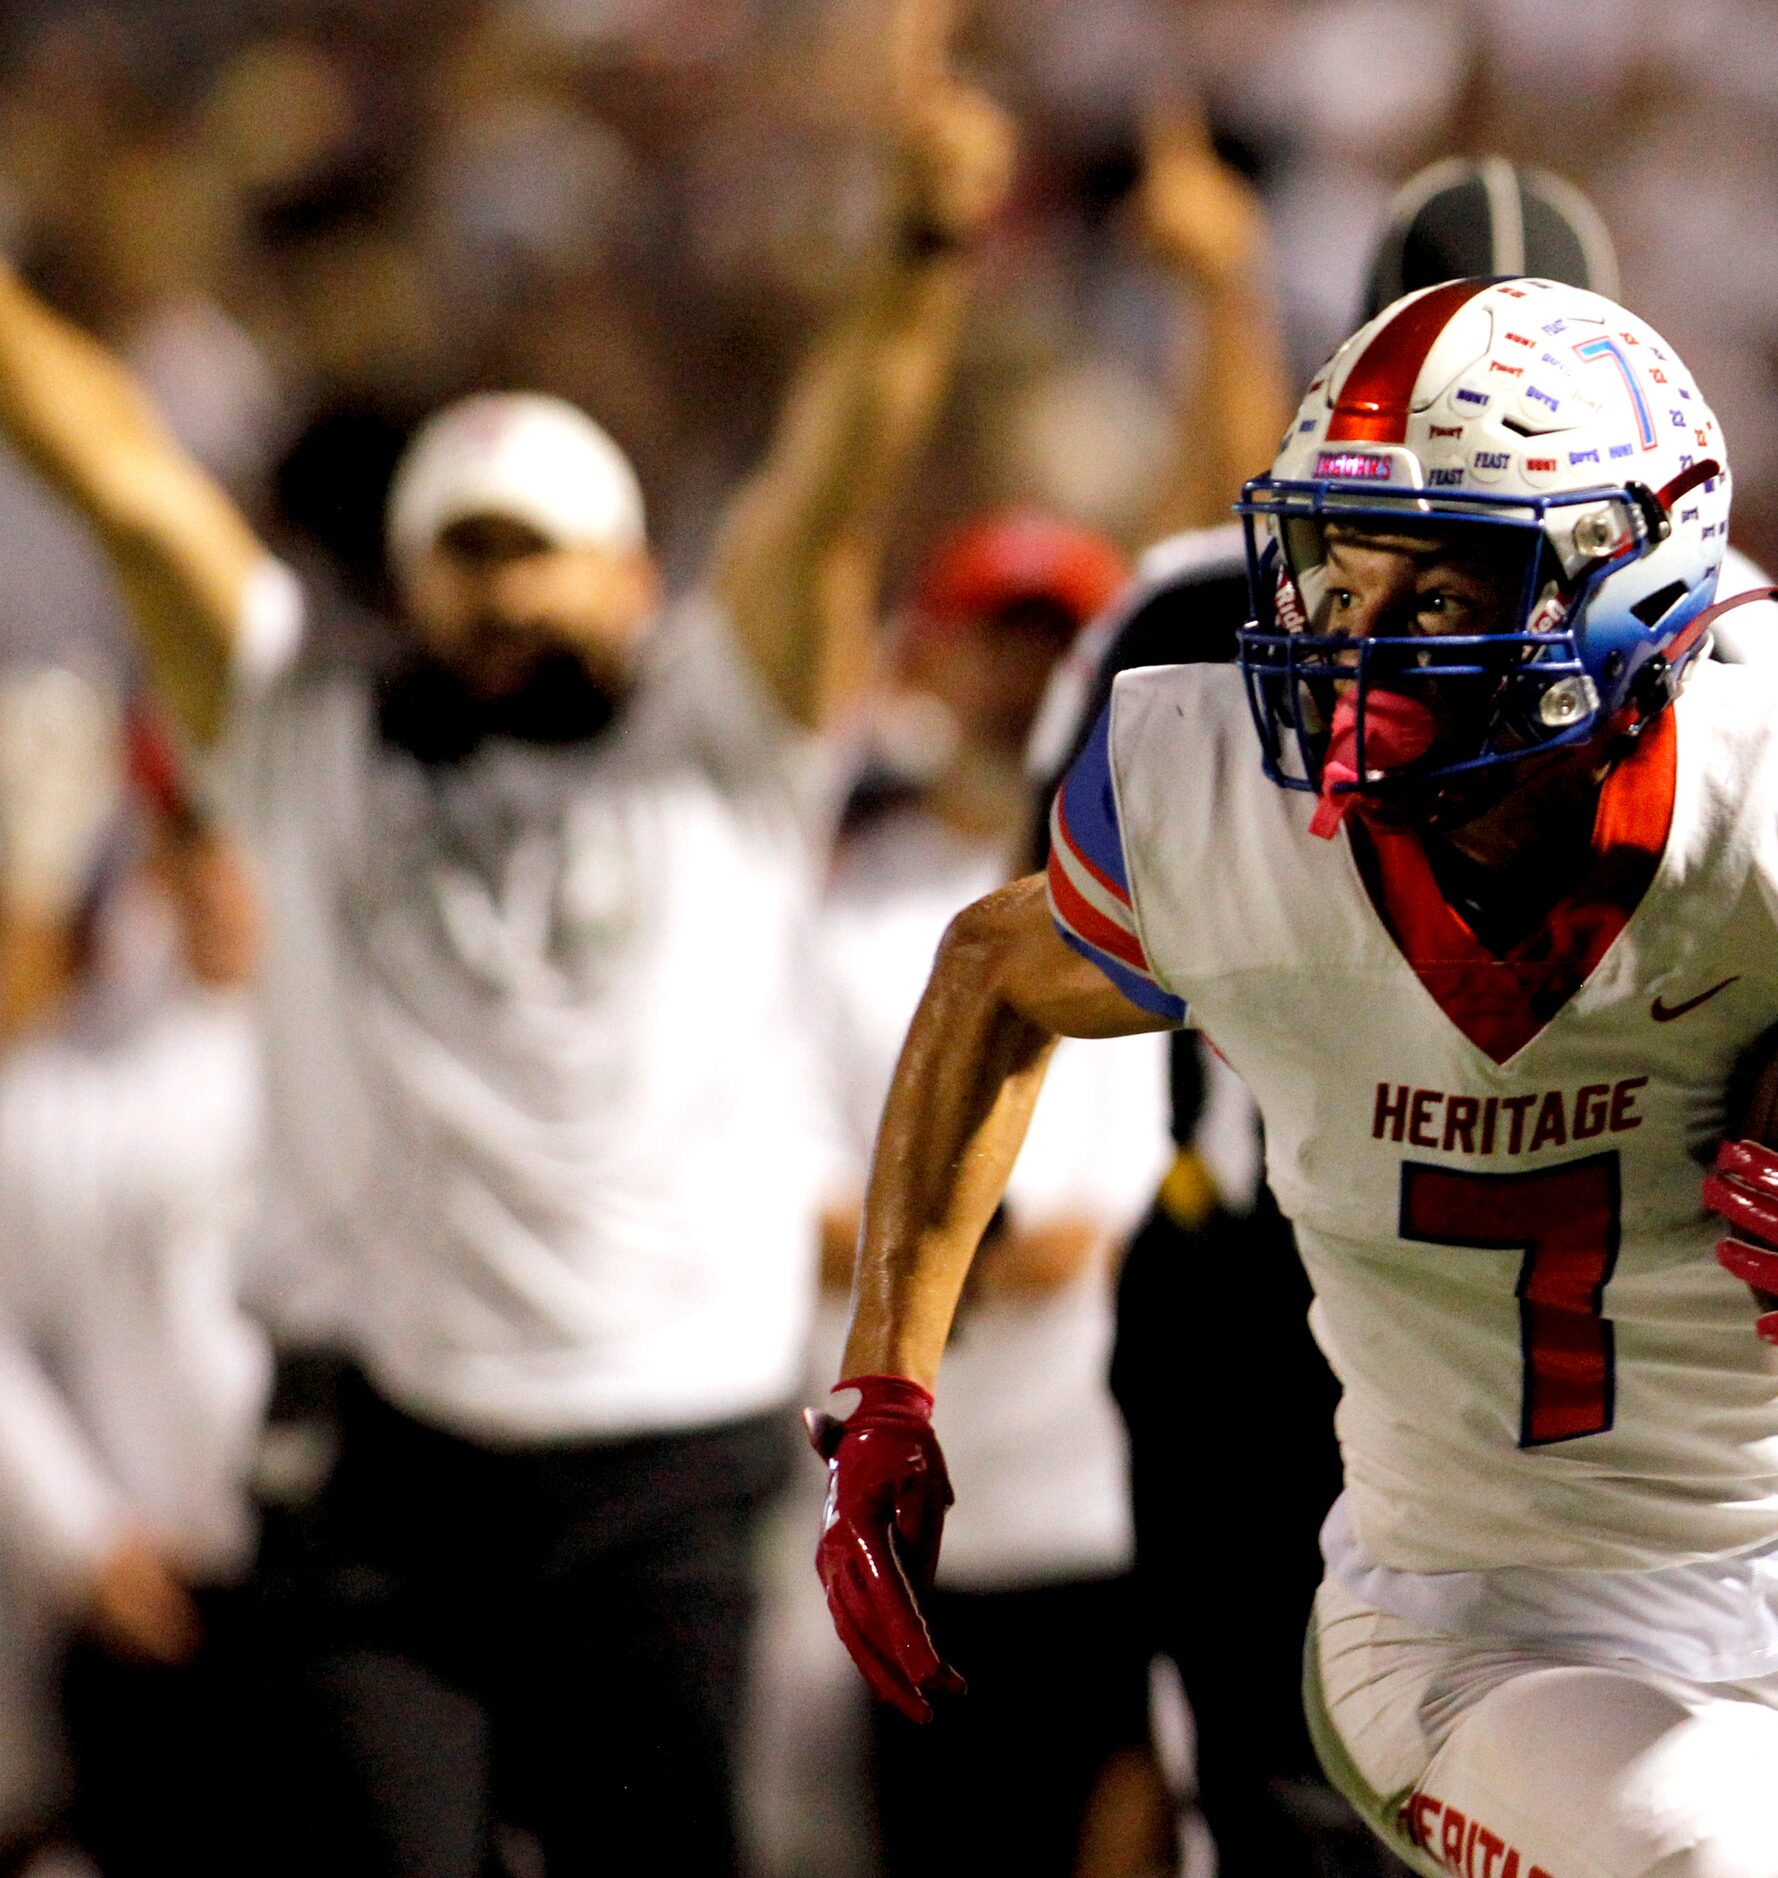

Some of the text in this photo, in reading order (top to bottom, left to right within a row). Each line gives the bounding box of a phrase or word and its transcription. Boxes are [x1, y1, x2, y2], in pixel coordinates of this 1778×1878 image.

[1570, 334, 1658, 452] 7
[1427, 468, 1464, 486] FEAST
[1473, 450, 1511, 470] FEAST
[1526, 457, 1557, 471] HUNT
[1372, 1076, 1649, 1155] HERITAGE
[1399, 1149, 1622, 1449] 7
